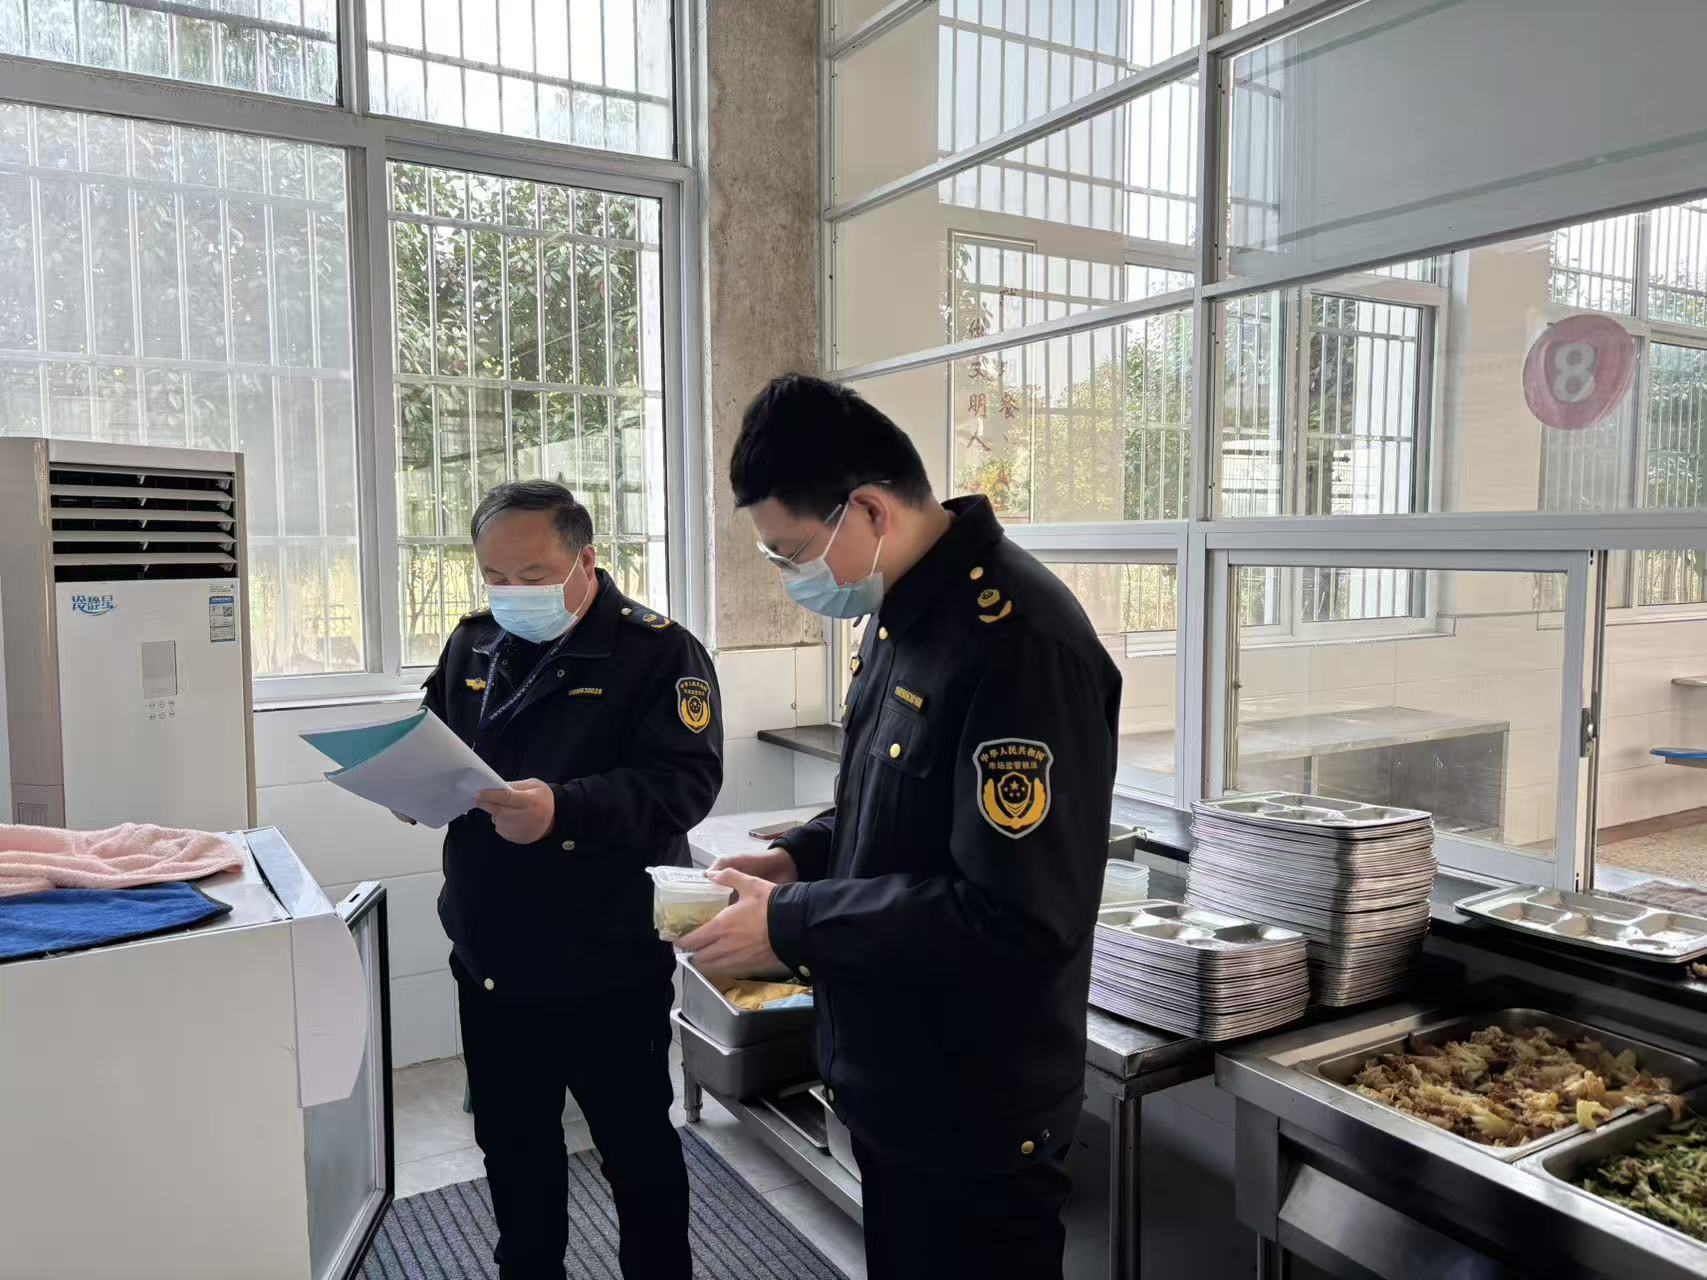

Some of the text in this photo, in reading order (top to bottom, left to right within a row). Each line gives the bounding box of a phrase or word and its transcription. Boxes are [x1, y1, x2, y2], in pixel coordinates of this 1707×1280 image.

[1553, 342, 1596, 402] 8
[980, 745, 1047, 762] 中华人民共和国
[988, 761, 1038, 770] 市场监管执法
